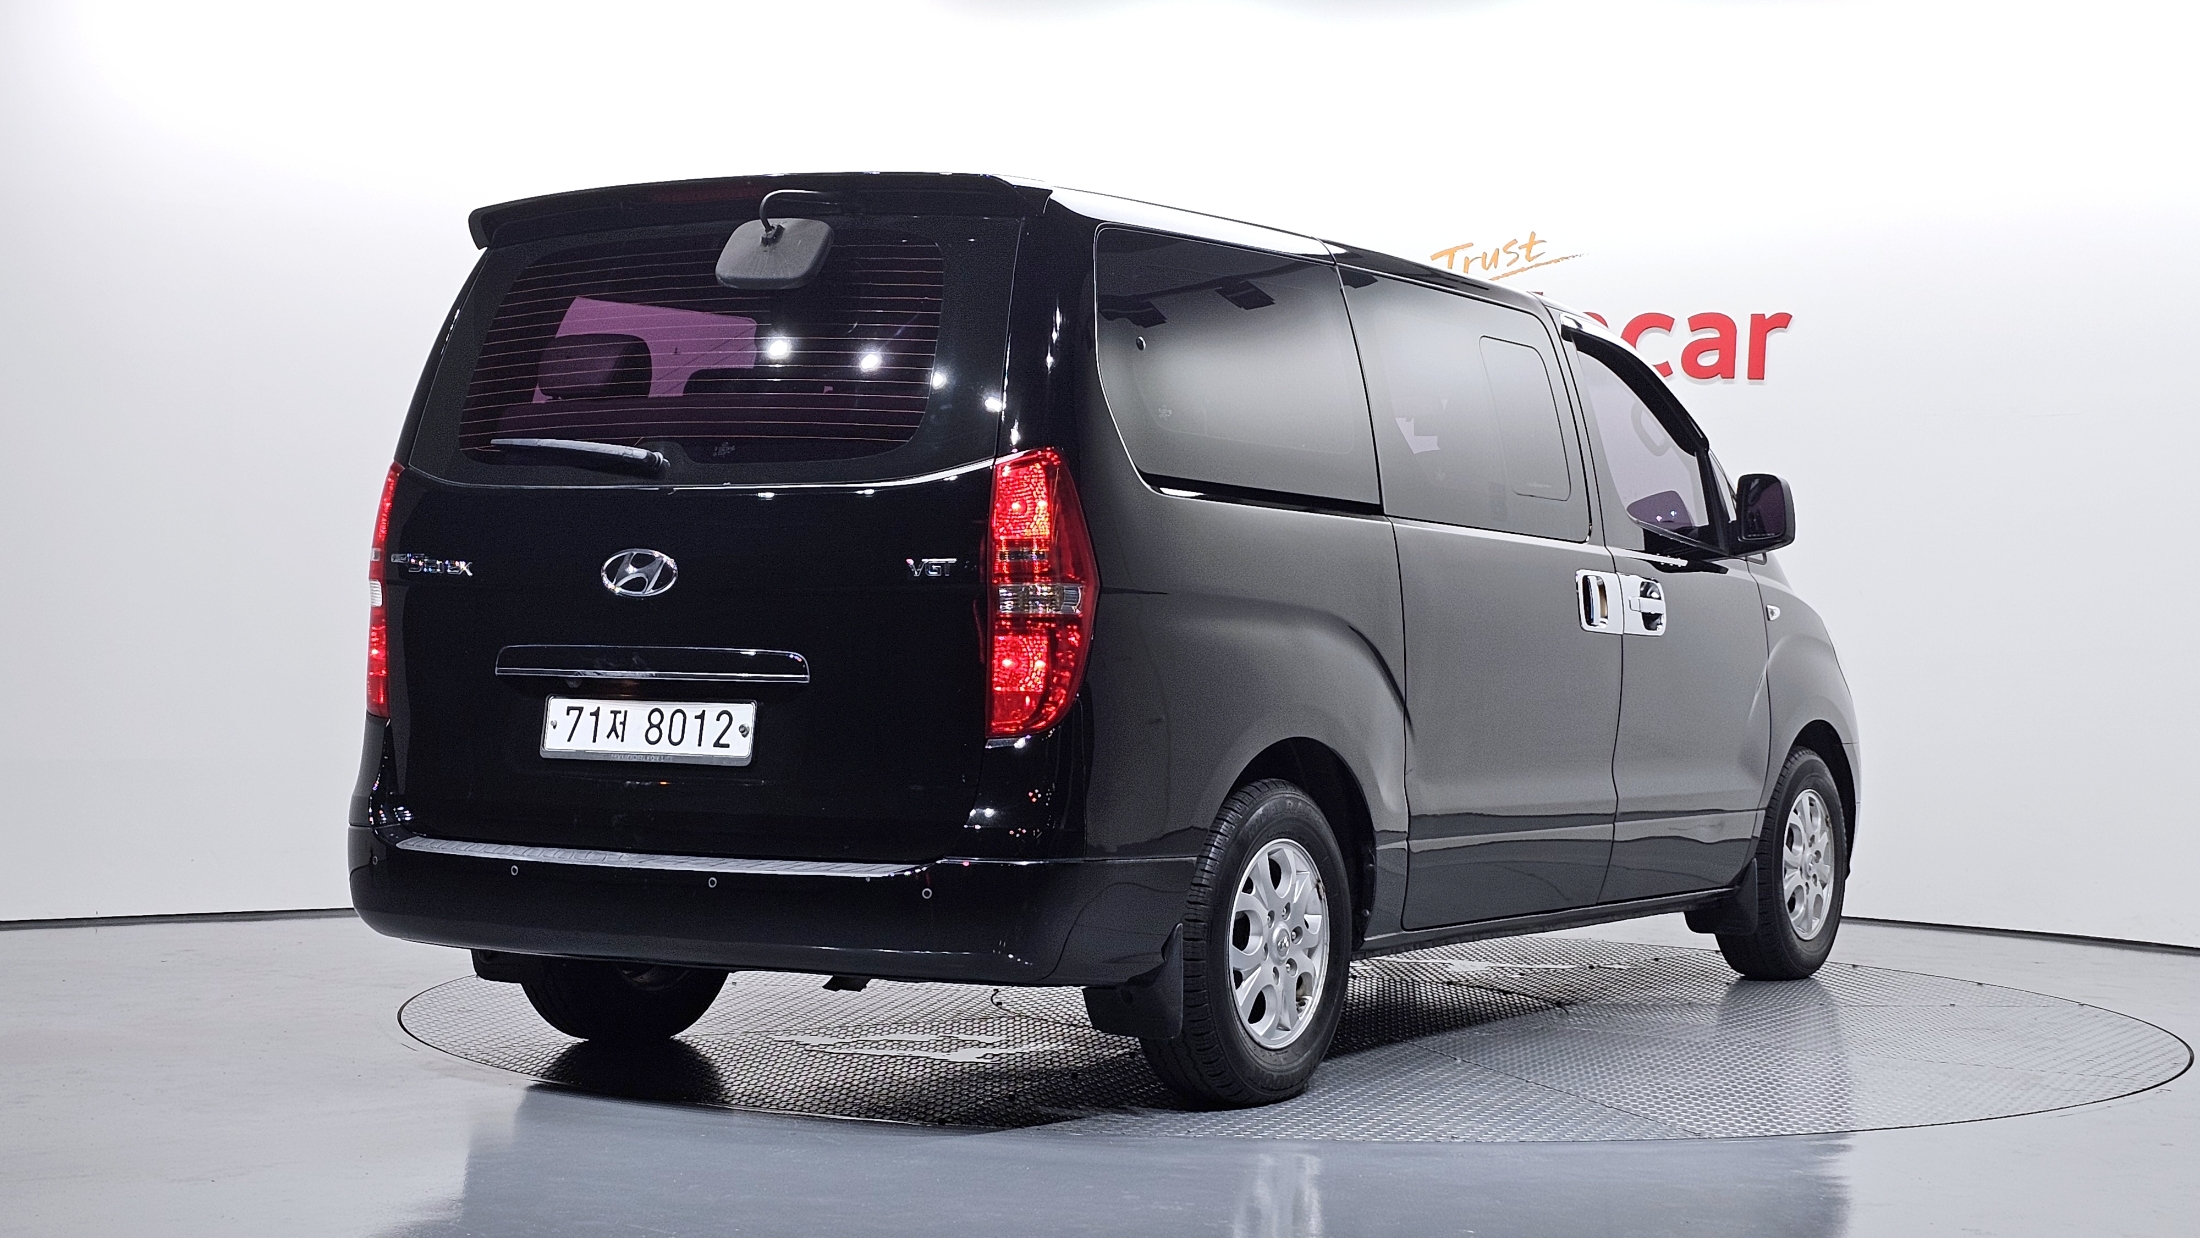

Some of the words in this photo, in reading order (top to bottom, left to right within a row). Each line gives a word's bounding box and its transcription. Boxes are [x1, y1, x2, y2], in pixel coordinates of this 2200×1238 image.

[1430, 231, 1547, 274] Trust
[1530, 291, 1793, 381] car
[905, 558, 957, 577] VGT
[566, 706, 628, 743] 71저
[644, 707, 734, 748] 8012
